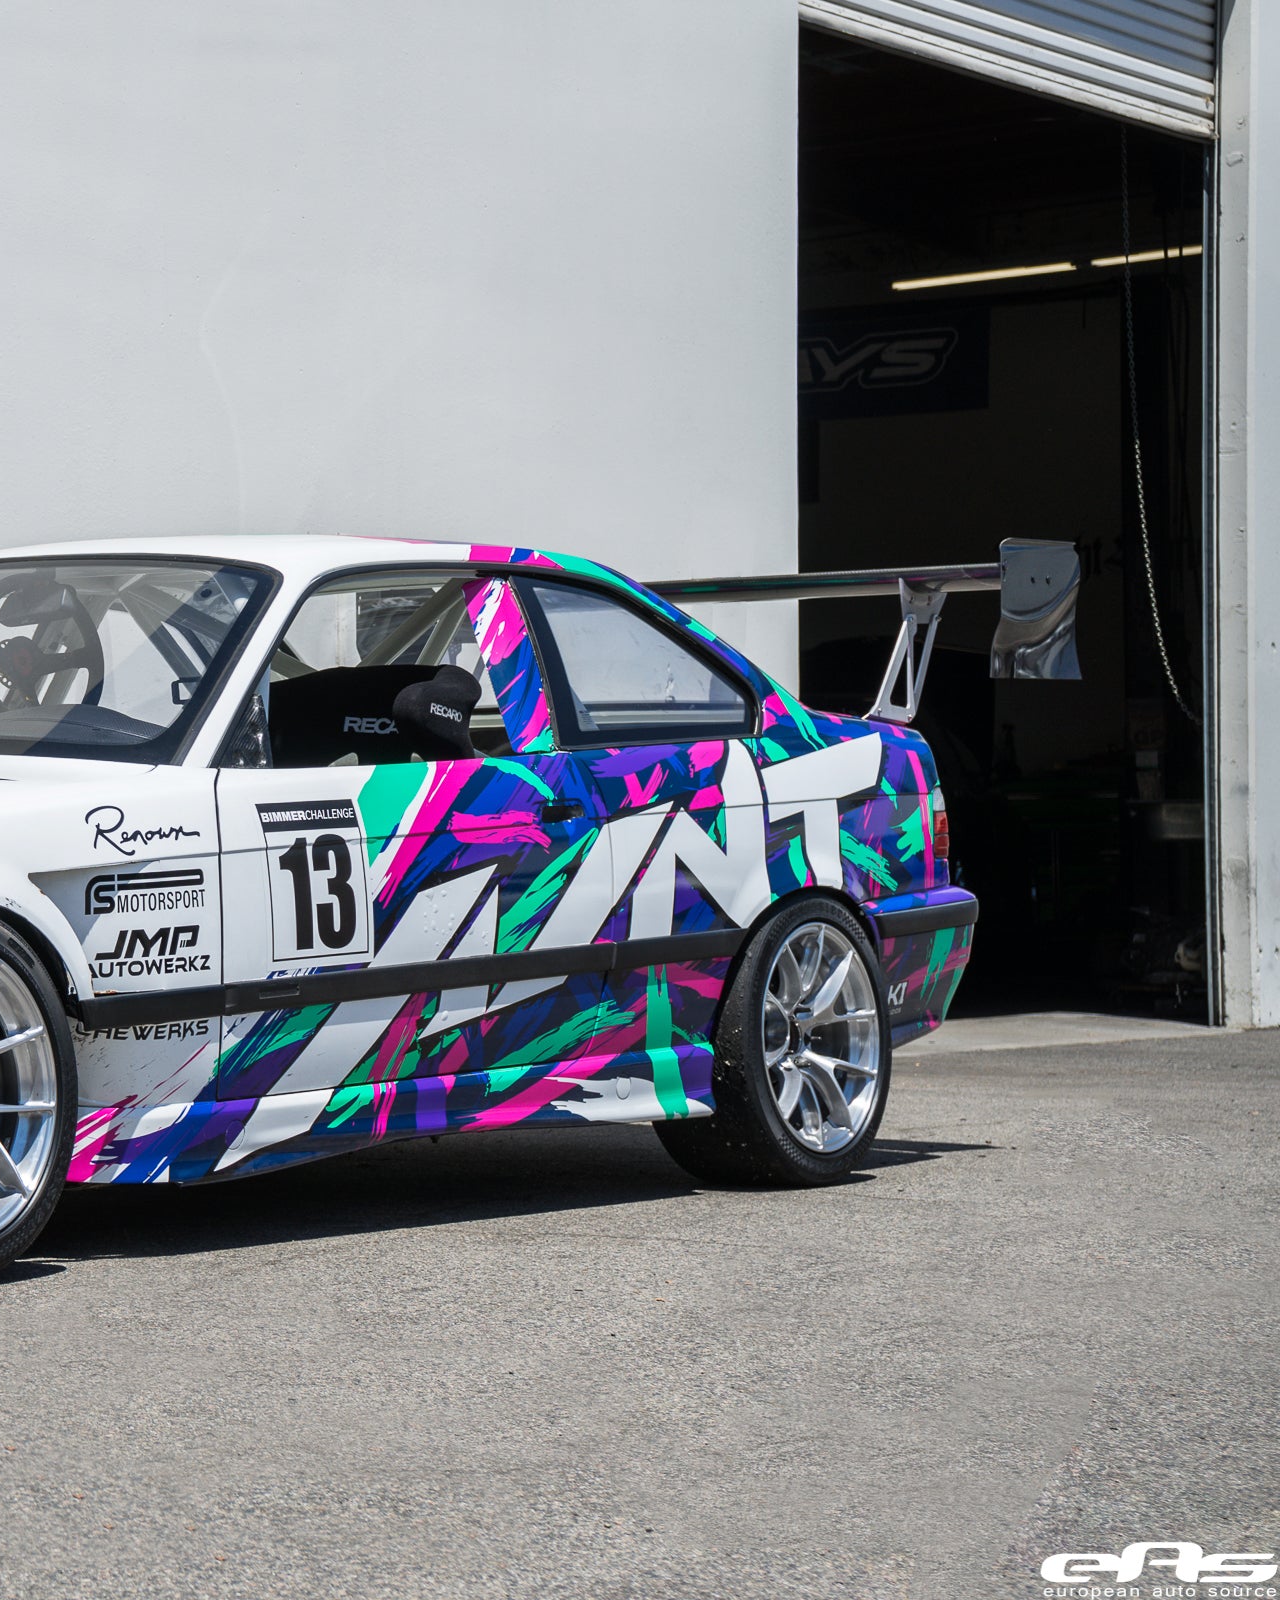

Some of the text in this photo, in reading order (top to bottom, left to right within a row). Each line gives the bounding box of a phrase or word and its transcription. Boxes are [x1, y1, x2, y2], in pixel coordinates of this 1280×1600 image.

[343, 716, 400, 735] RECA
[429, 702, 463, 723] RECARO
[85, 805, 201, 856] Renown
[117, 889, 206, 914] MOTORSPORT
[278, 833, 357, 951] 13
[94, 924, 201, 961] JMP
